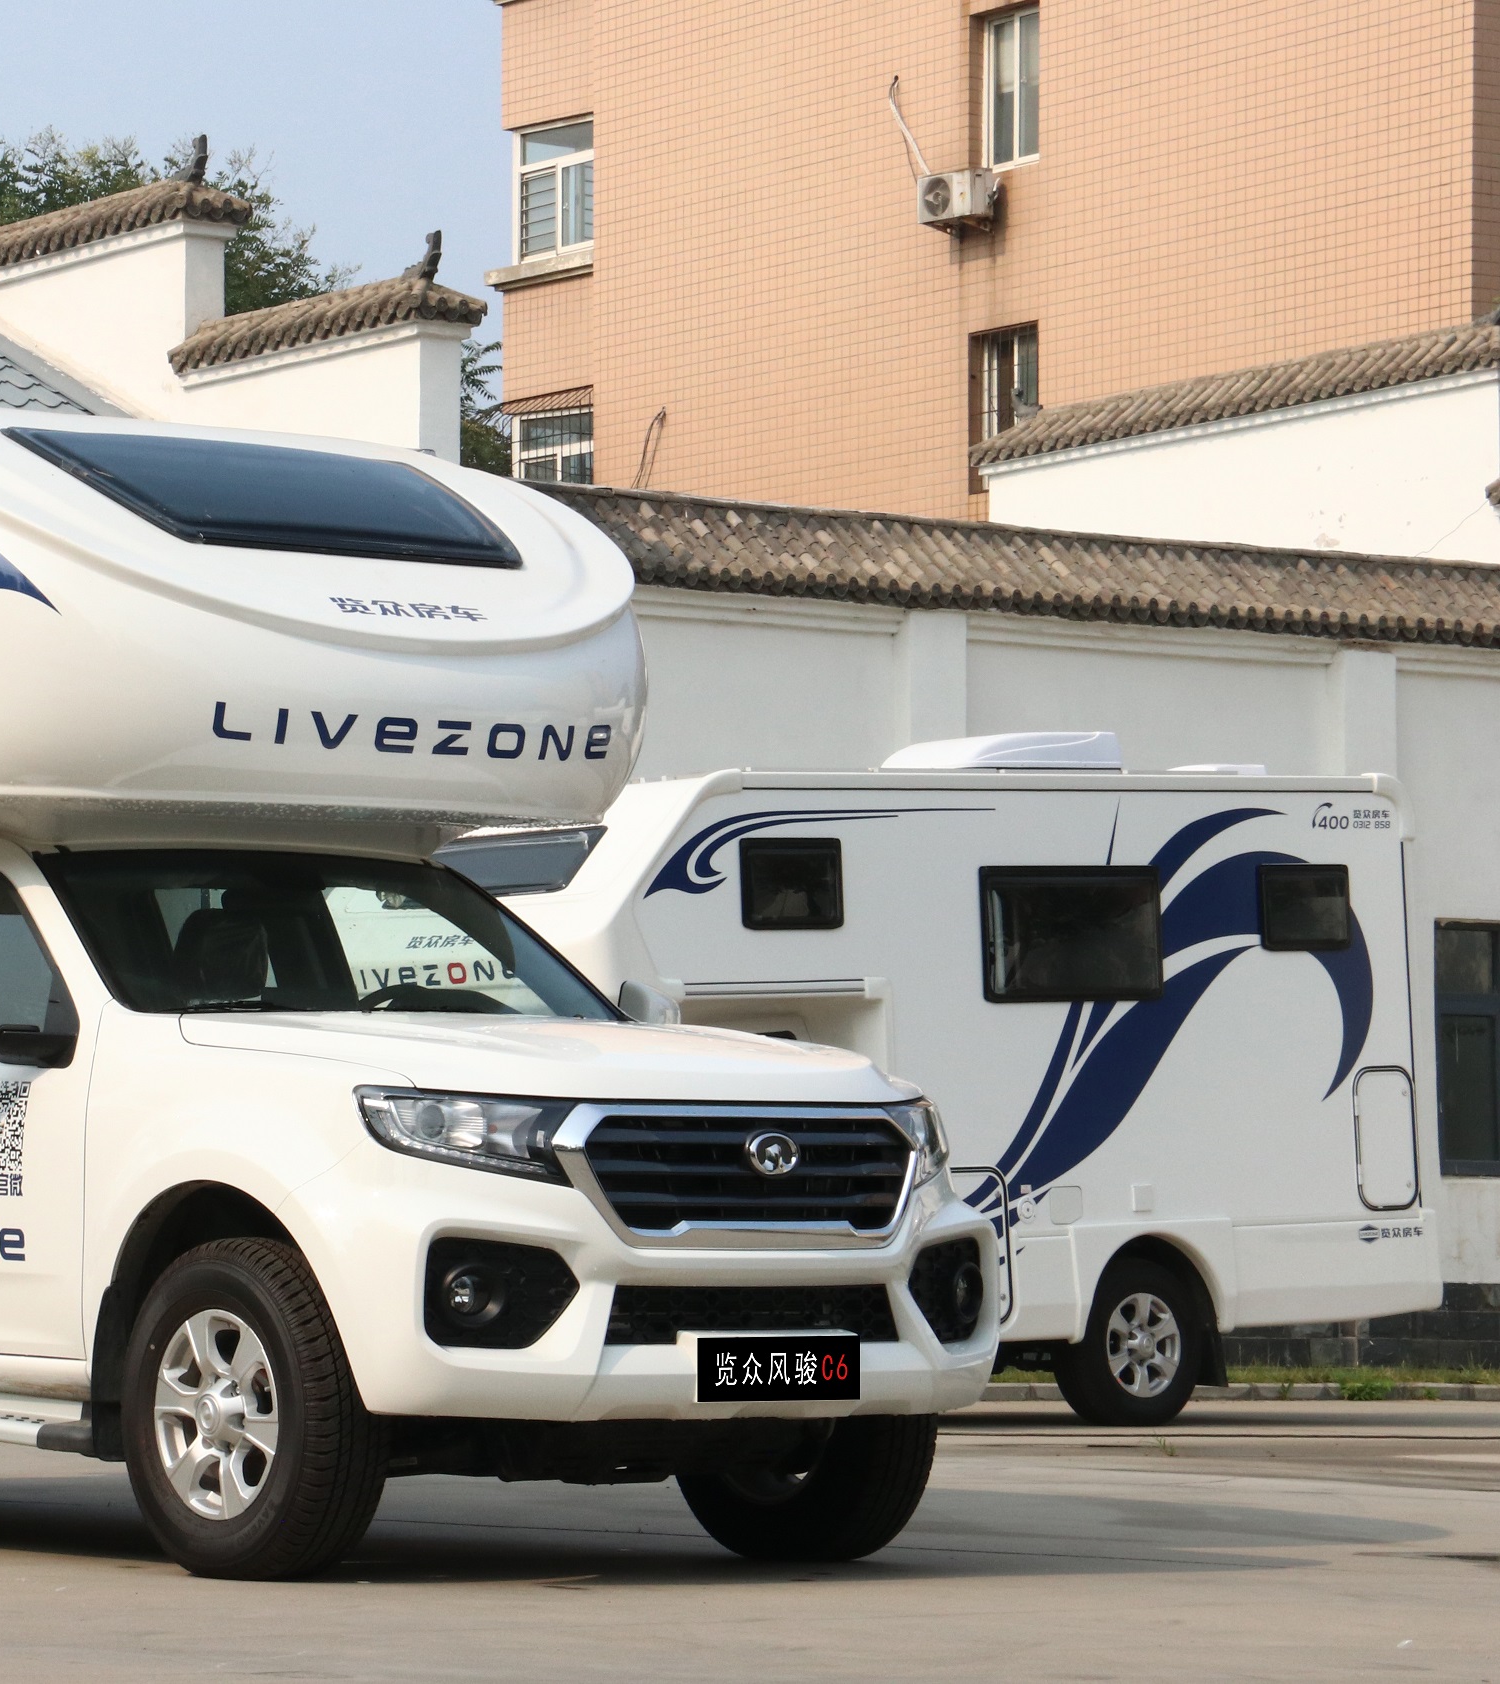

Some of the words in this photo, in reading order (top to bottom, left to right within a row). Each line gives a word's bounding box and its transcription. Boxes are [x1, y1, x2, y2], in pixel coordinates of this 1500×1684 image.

[329, 597, 488, 621] 览众房车
[1318, 816, 1350, 830] 400
[1353, 821, 1371, 829] 0312
[1374, 820, 1391, 829] 858
[405, 935, 474, 949] 览众房车
[1381, 1226, 1423, 1239] 览众房车
